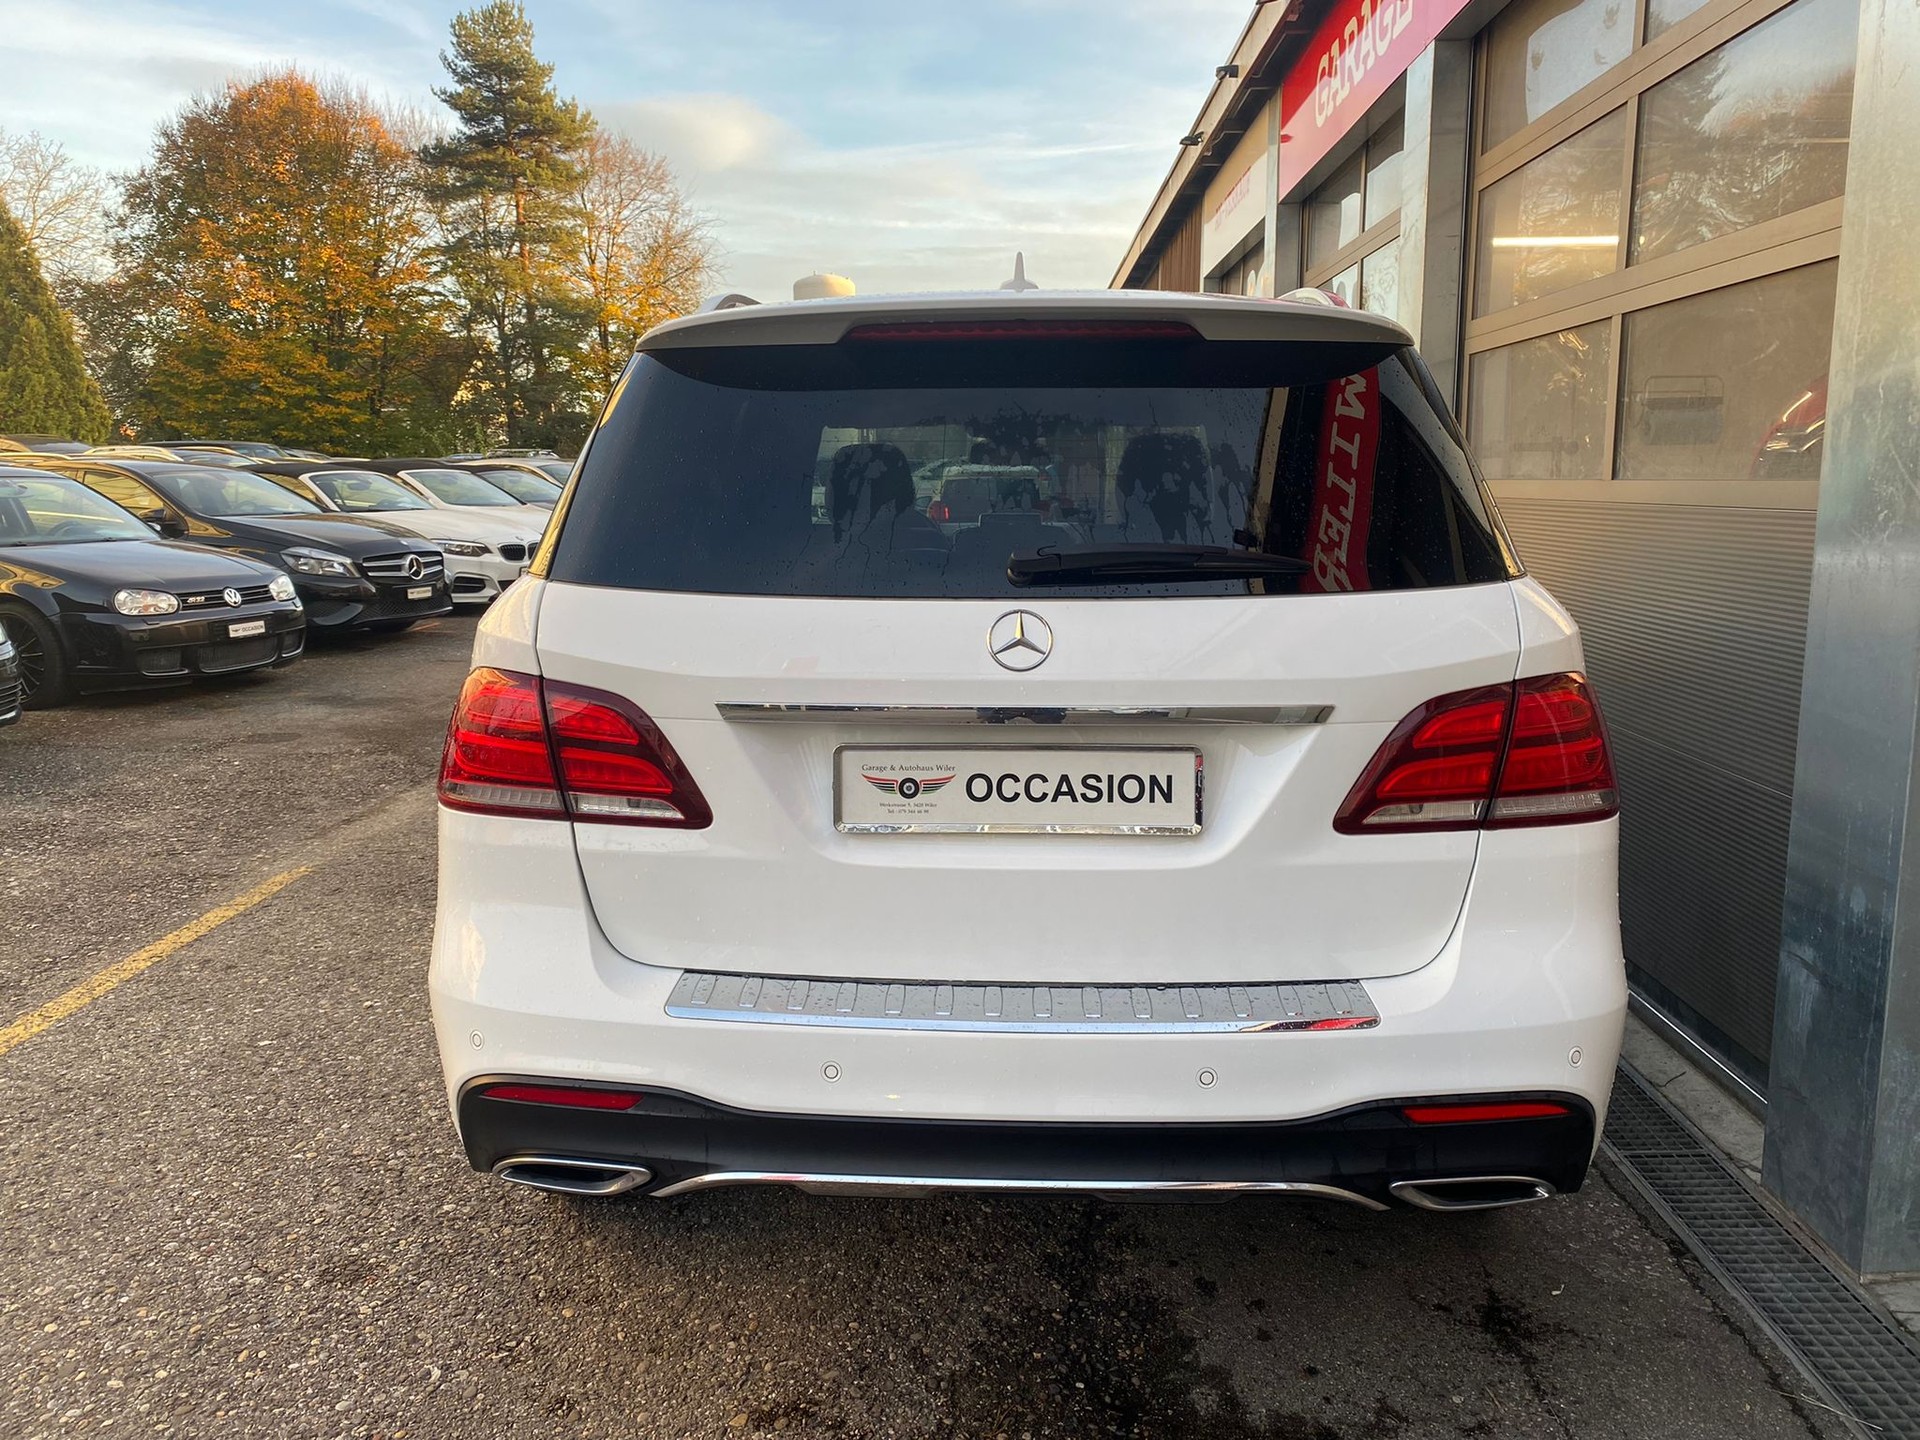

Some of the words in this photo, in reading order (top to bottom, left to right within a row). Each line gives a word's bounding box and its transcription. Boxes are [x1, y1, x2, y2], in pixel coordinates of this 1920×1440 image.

[861, 764, 888, 773] Garage
[889, 764, 896, 772] &
[899, 764, 934, 772] Autohaus
[935, 764, 956, 772] Wiler
[965, 773, 1173, 804] OCCASION
